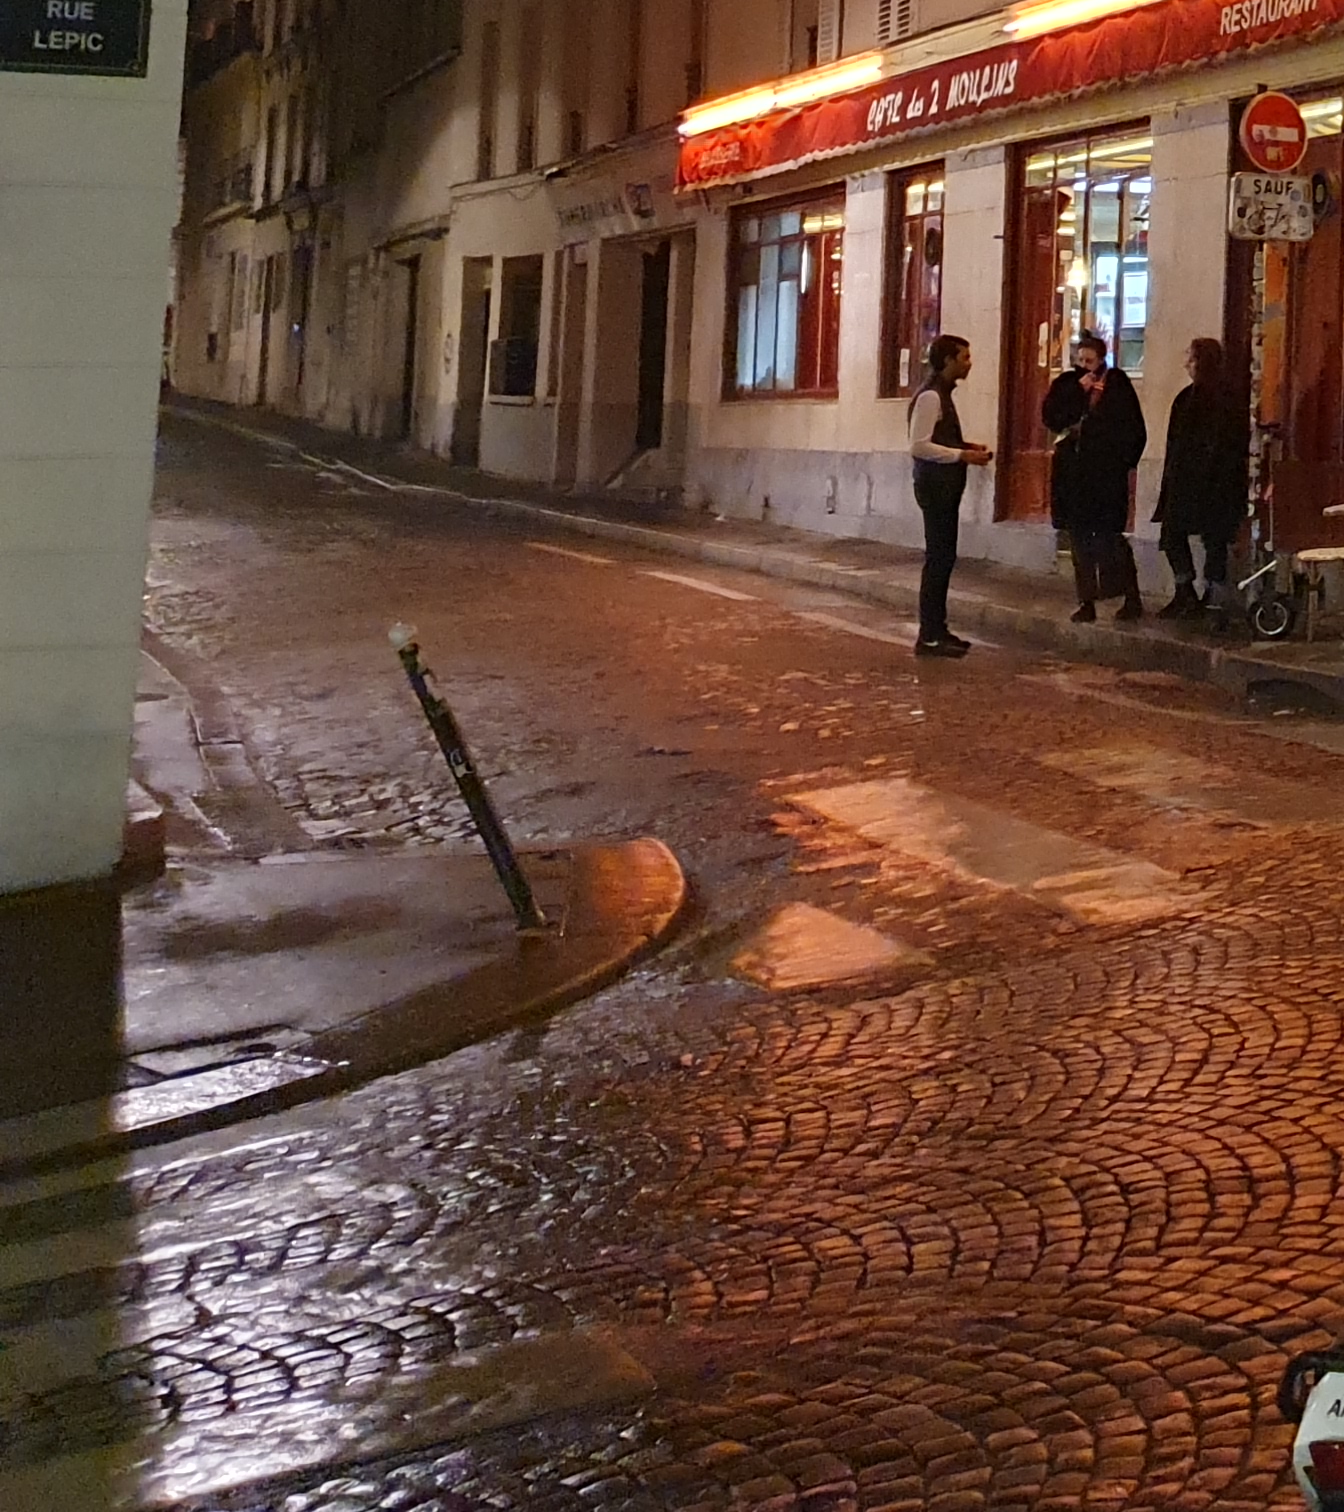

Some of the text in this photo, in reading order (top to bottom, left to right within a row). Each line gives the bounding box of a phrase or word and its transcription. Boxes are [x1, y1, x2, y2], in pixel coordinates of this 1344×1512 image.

[46, 0, 95, 20] RUE
[34, 30, 104, 51] LEPIC
[906, 88, 924, 119] des
[928, 79, 939, 116] 2
[945, 59, 1018, 111] MOULINS
[1253, 179, 1294, 196] SAUF
